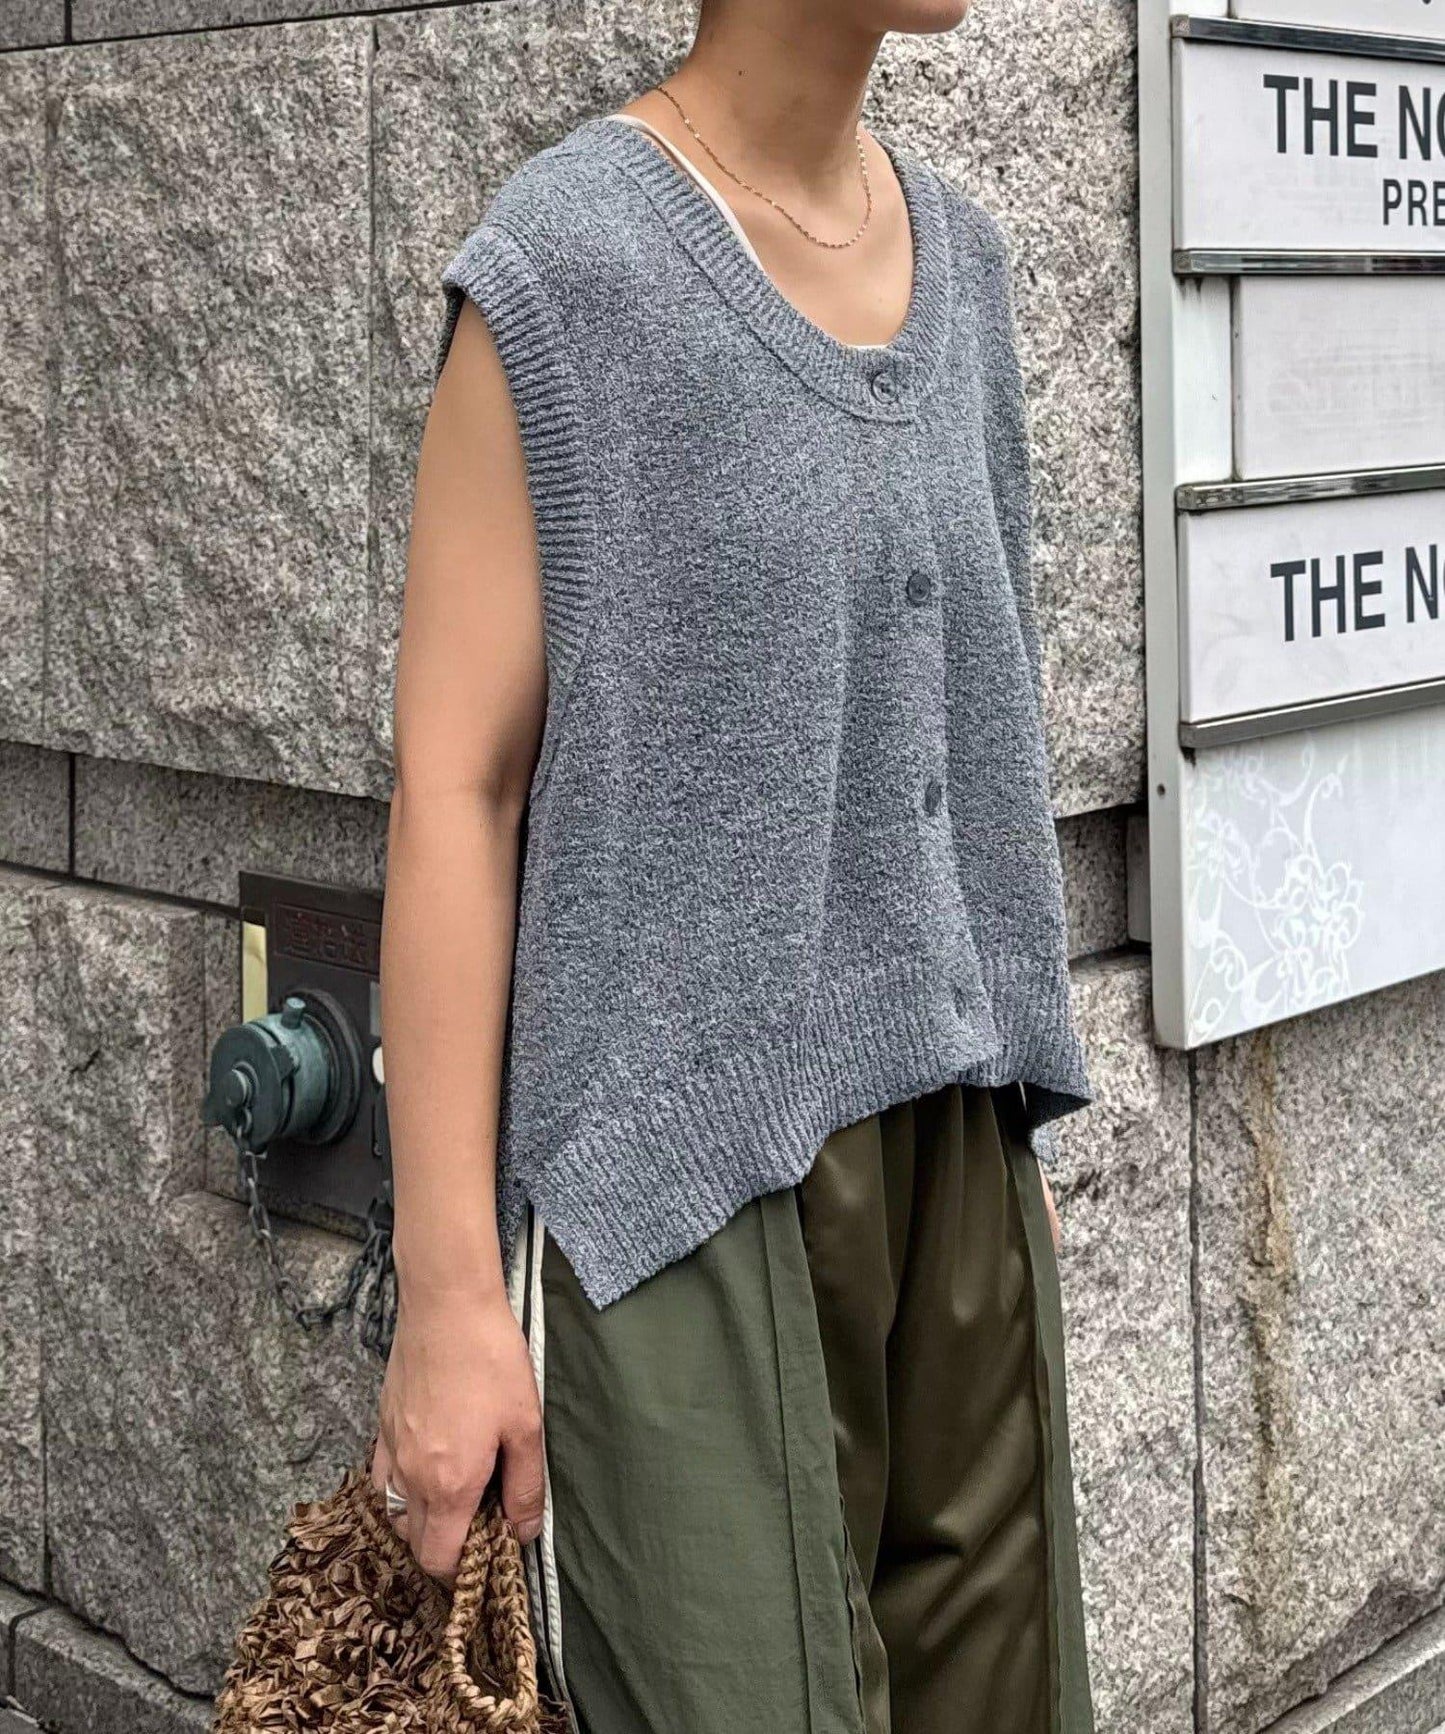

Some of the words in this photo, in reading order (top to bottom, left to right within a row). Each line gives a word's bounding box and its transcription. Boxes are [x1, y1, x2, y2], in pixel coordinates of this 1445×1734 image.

[1263, 74, 1378, 158] THE
[1398, 85, 1445, 161] N
[1270, 550, 1386, 642] THE
[1405, 544, 1445, 623] N
